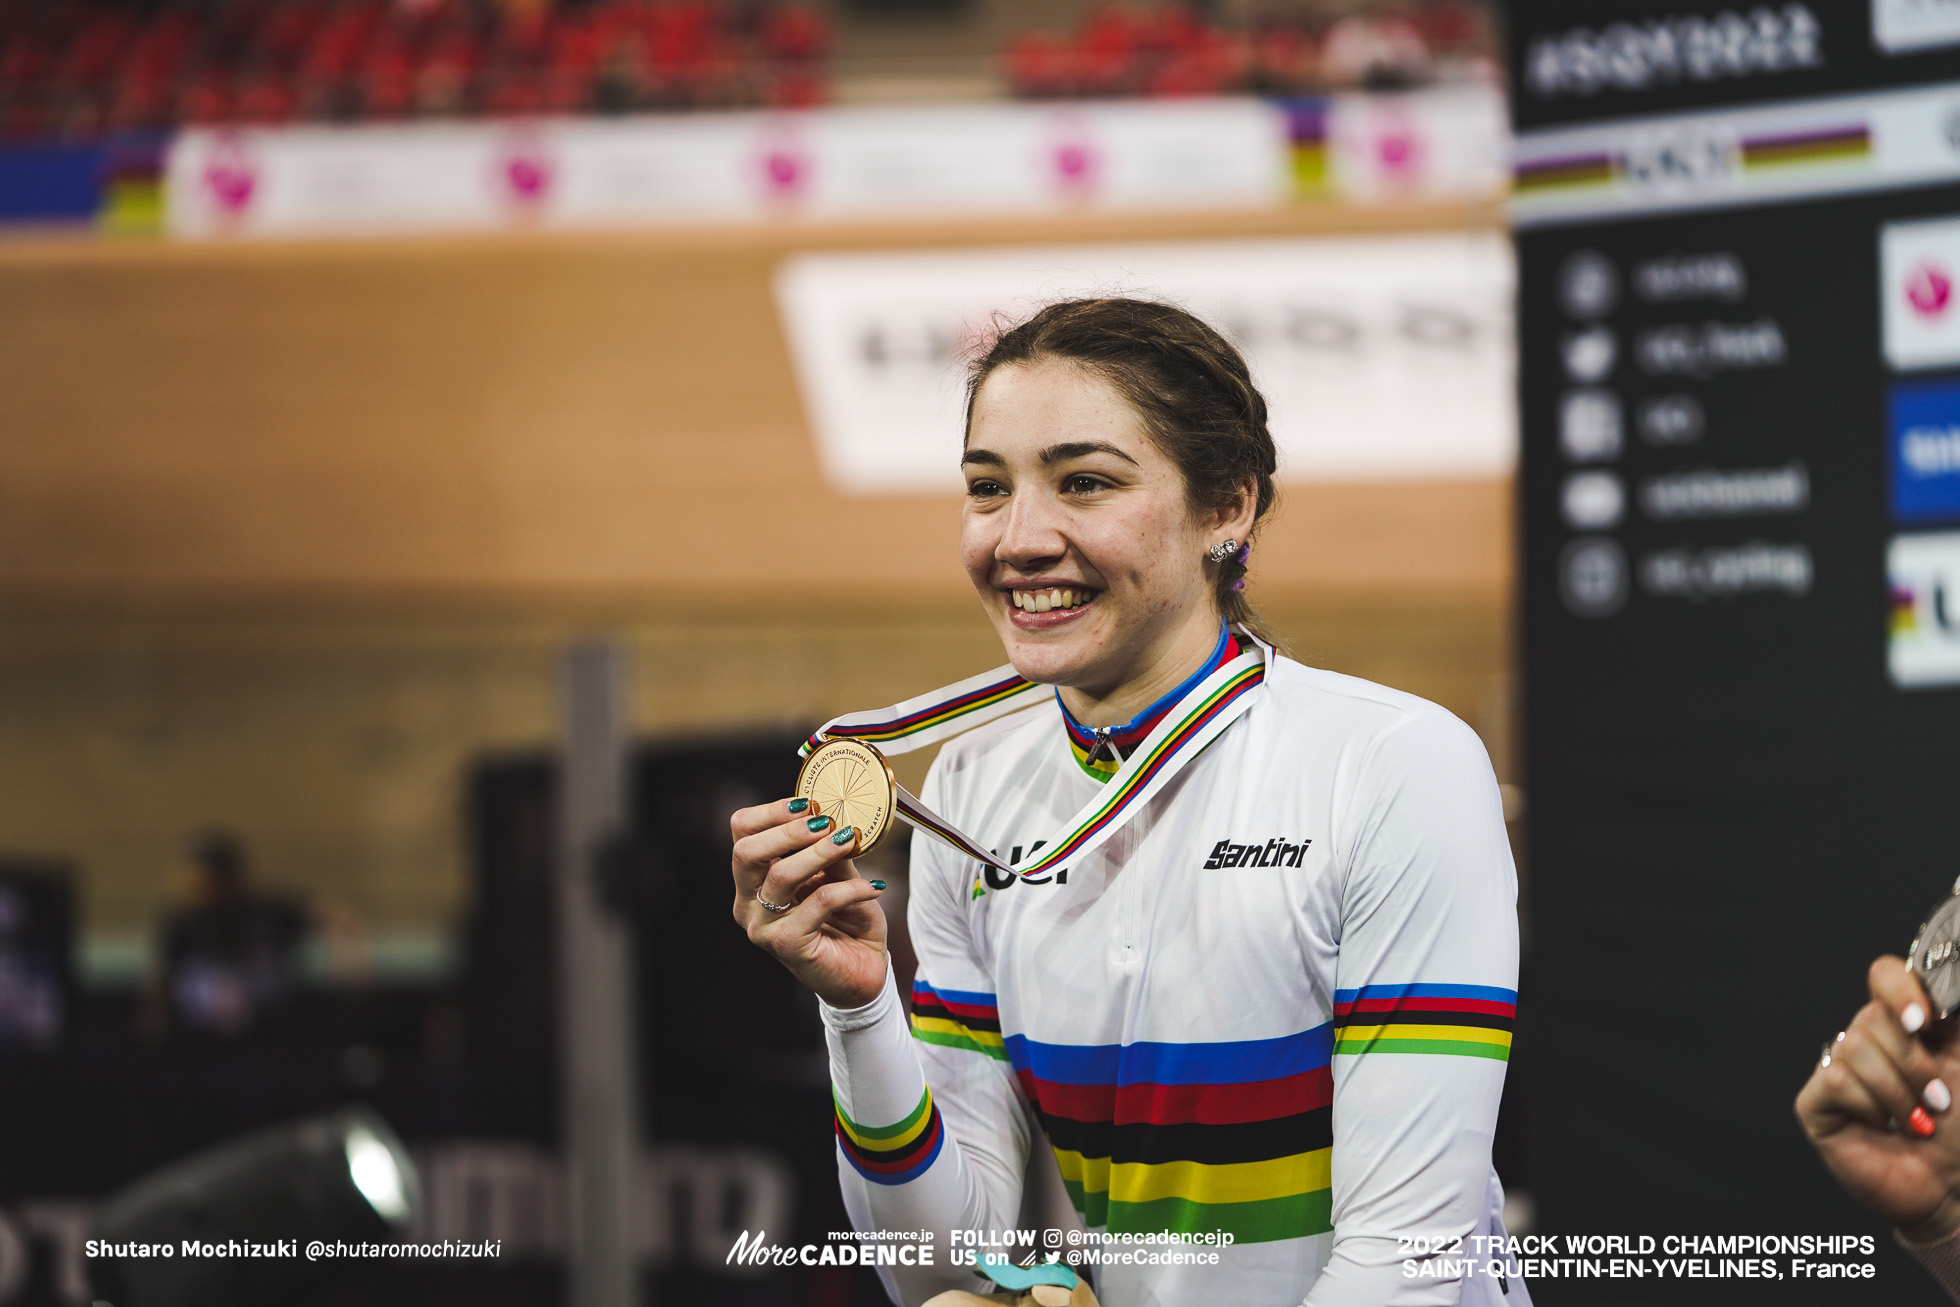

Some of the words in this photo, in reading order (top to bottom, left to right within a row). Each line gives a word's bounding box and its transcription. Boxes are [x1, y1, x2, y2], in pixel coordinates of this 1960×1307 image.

[803, 761, 822, 795] CYCLISTE
[819, 748, 871, 766] INTERNATIONALE
[863, 806, 883, 839] SCRATCH
[1203, 837, 1313, 870] Santini
